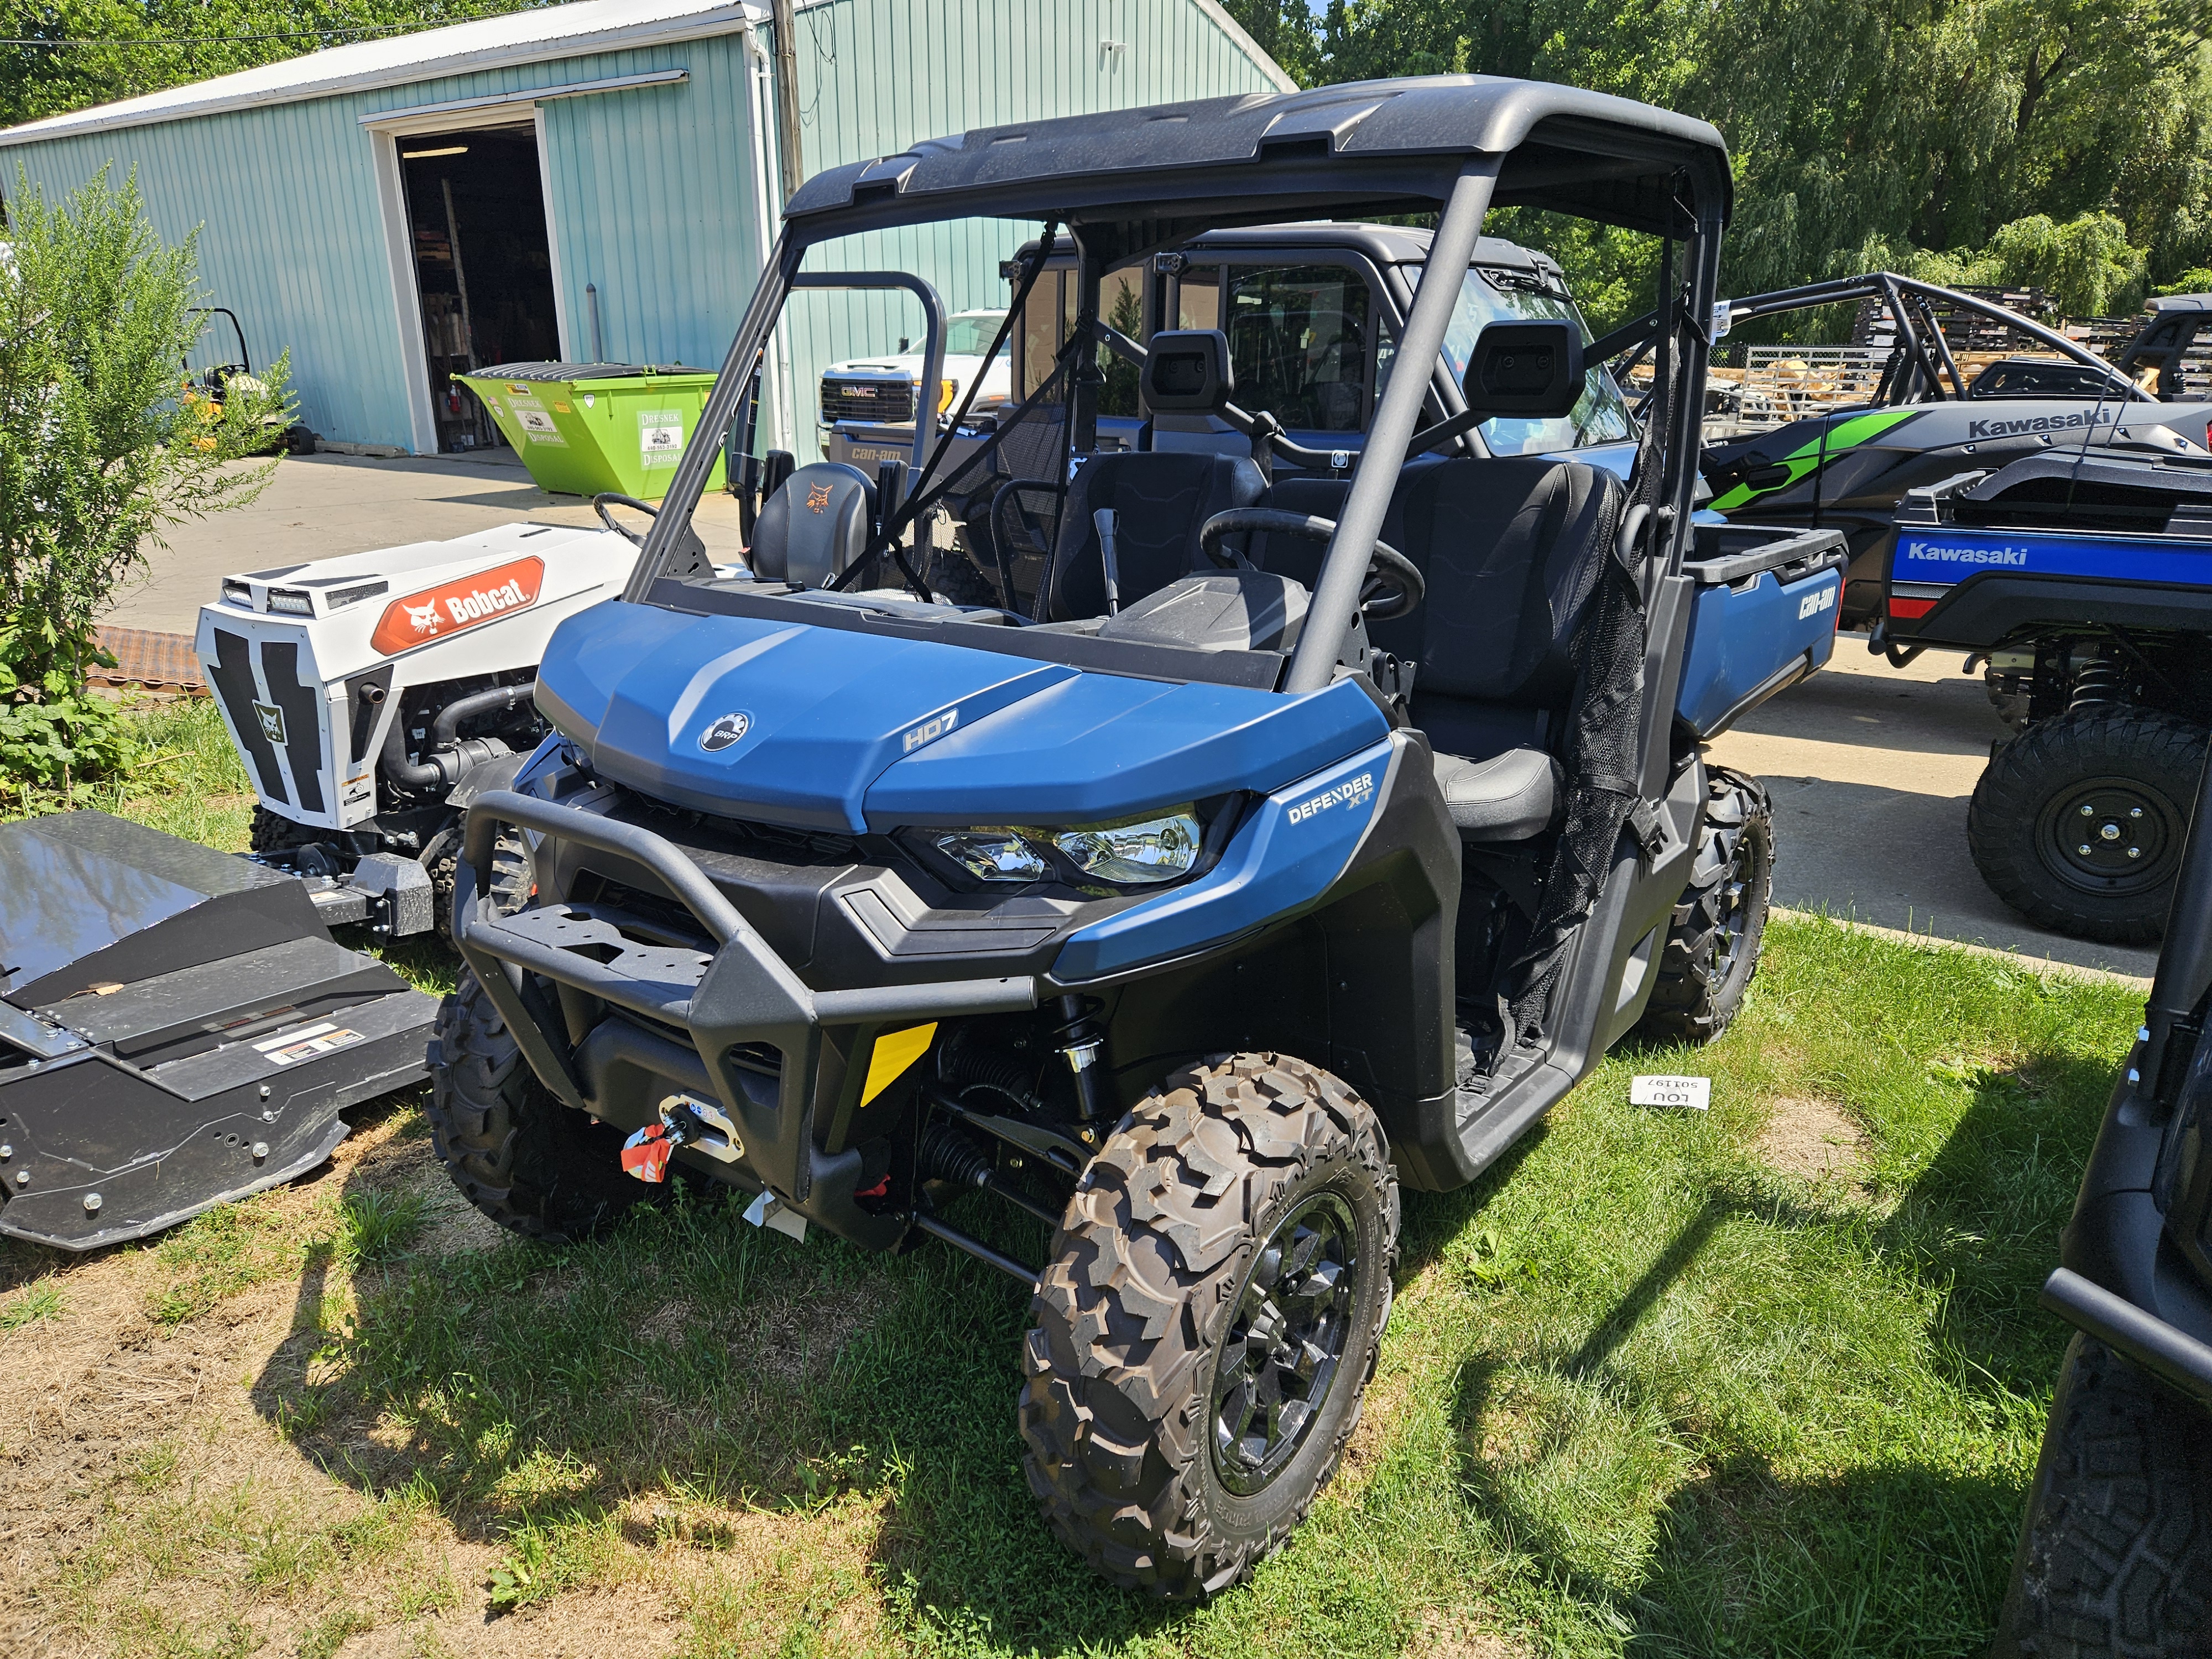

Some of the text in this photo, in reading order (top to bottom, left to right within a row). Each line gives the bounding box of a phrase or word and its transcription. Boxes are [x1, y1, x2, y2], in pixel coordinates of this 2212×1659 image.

[842, 387, 875, 398] GMC
[508, 398, 542, 408] DRESNEK
[641, 414, 679, 425] DRESNEK
[1970, 408, 2110, 439] Kawasaki
[528, 432, 564, 443] DISPOSAL
[643, 453, 682, 466] DISPOSAL
[852, 447, 901, 461] can-am
[1908, 542, 2028, 565] Kawasaki
[445, 578, 526, 624] Bobcat
[1799, 586, 1836, 620] can-am
[713, 729, 738, 739] BRP
[905, 709, 957, 751] HD7
[1288, 773, 1373, 825] DEFENDER
[1348, 787, 1373, 809] XT
[1648, 1079, 1698, 1088] 501197
[1653, 1093, 1689, 1102] LOU
